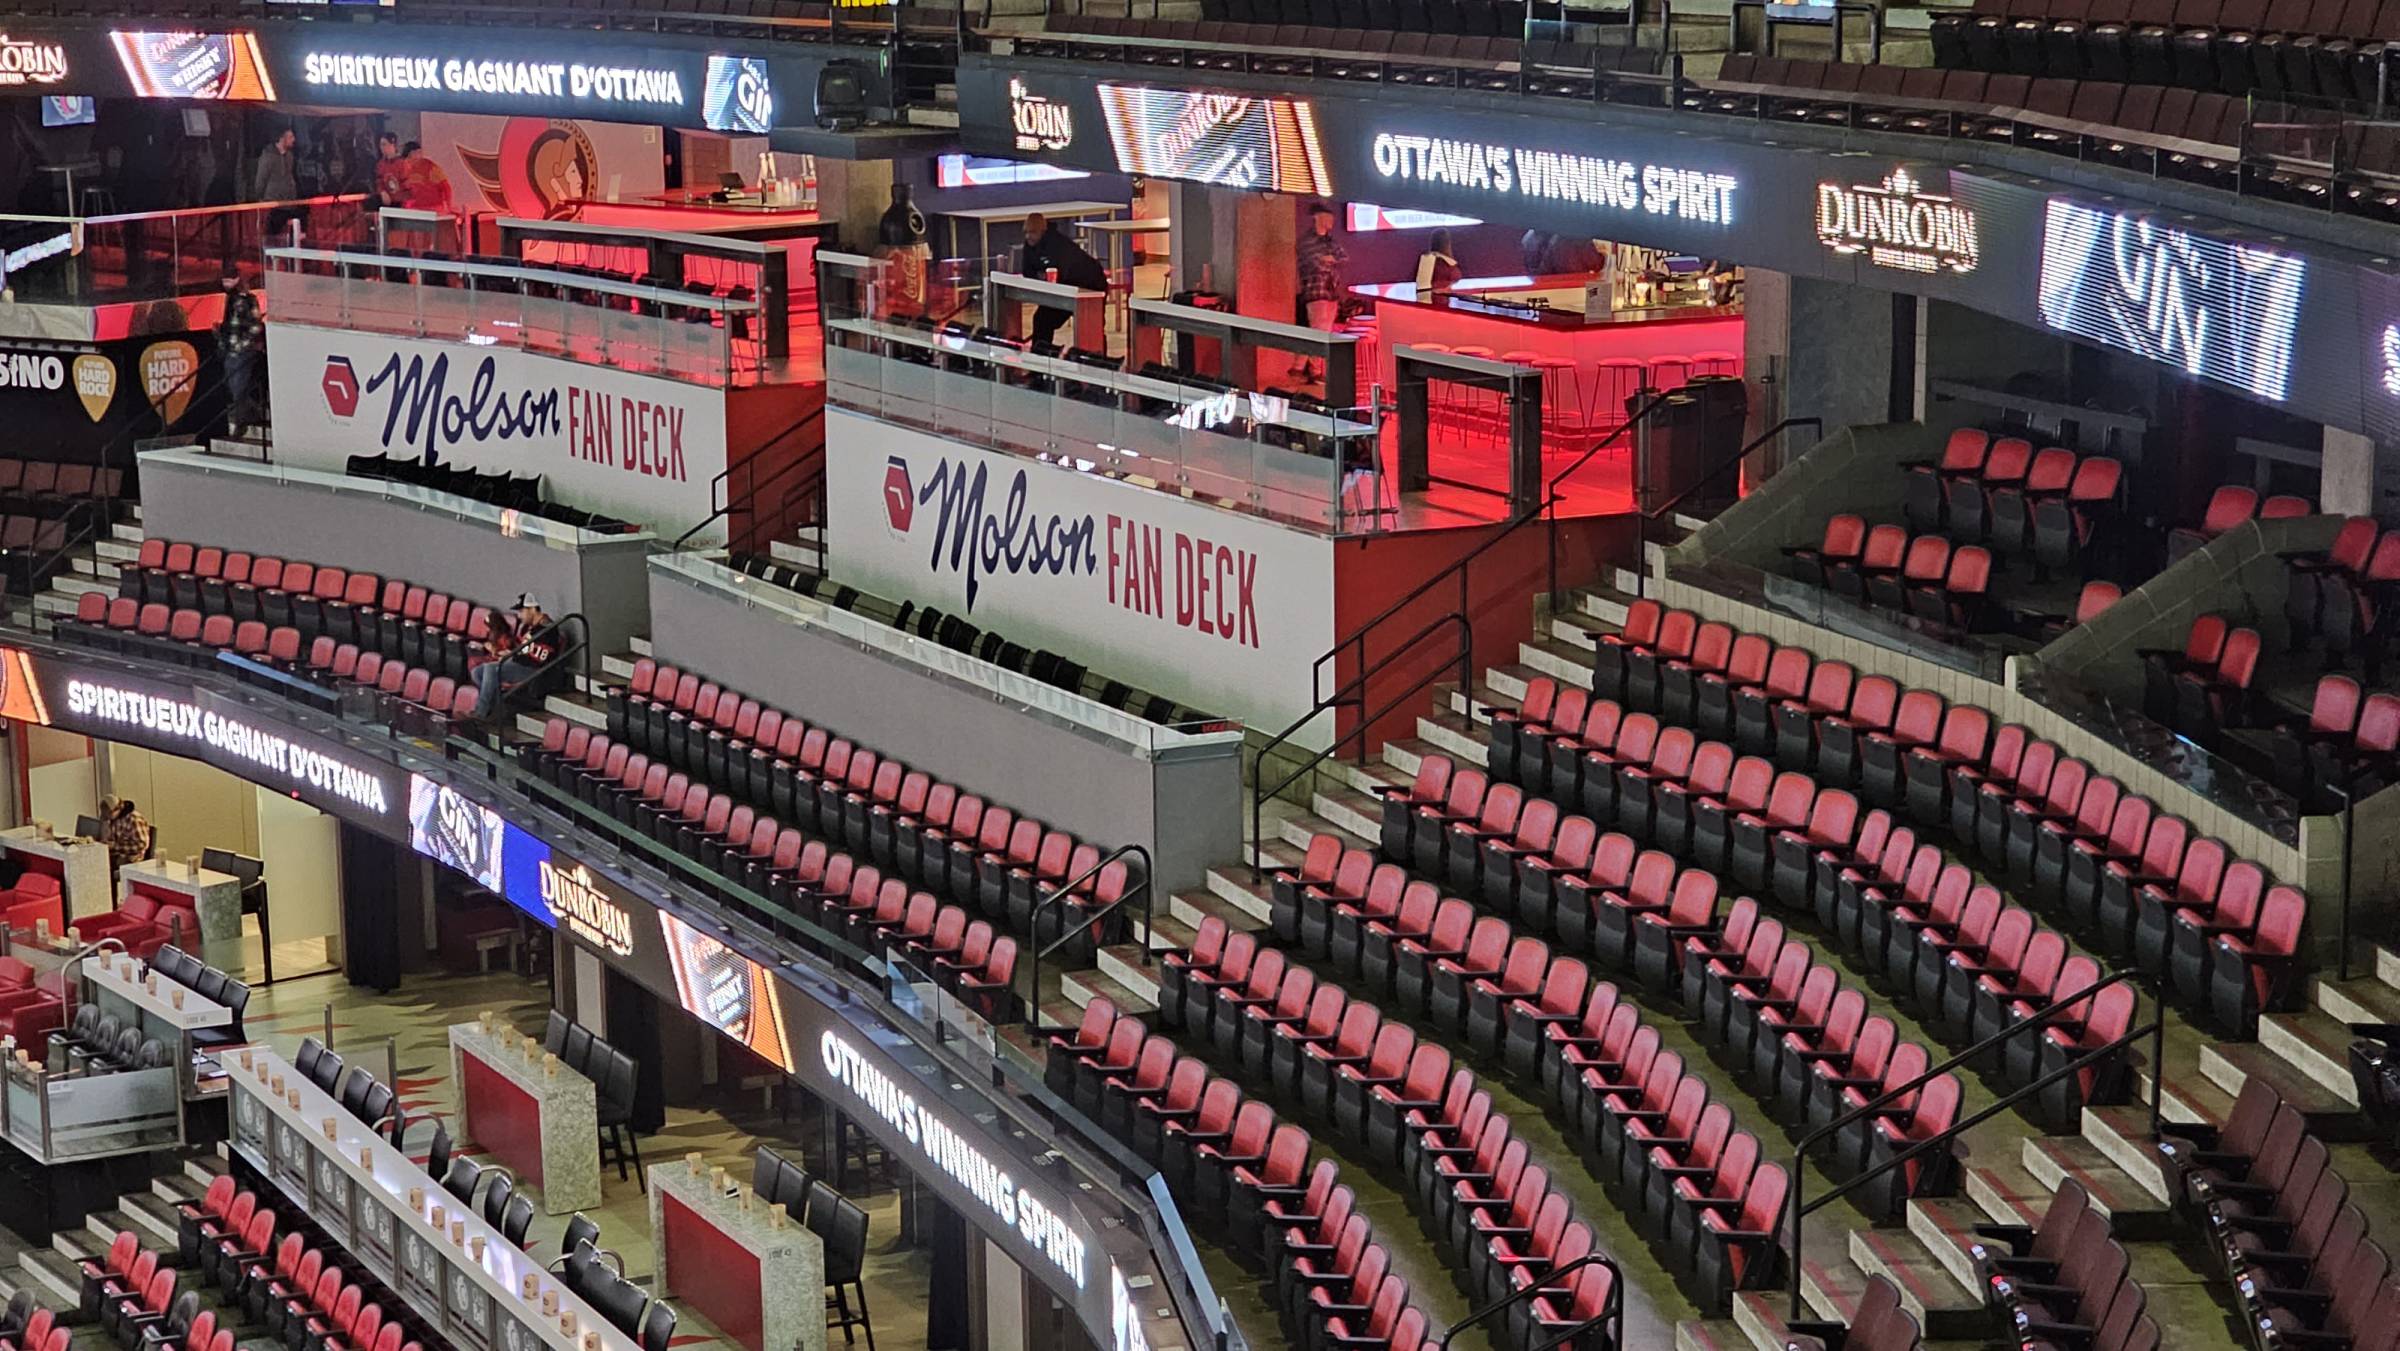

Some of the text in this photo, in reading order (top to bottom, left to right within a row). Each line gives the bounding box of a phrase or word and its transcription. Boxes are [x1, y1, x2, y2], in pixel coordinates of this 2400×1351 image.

[0, 46, 63, 75] OBIN
[305, 53, 684, 105] SPIRITUEUX GAGNANT D'OTTAWA
[1373, 133, 1737, 225] OTTAWA'S WINNING SPIRIT
[1816, 183, 1977, 256] DUNROBIN
[78, 369, 110, 383] HARD
[78, 382, 110, 397] ROCK
[147, 360, 189, 378] HARD
[148, 376, 189, 397] ROCK
[366, 352, 686, 482] Molson FAN DECK
[919, 457, 1259, 648] Molson FAN DECK
[67, 680, 387, 813] SPIRITUEUX GAGNANT D'OTTAWA
[539, 861, 633, 946] DUNROBIN
[821, 1030, 1085, 1289] OTTAWA'S WINNING SPIRIT
